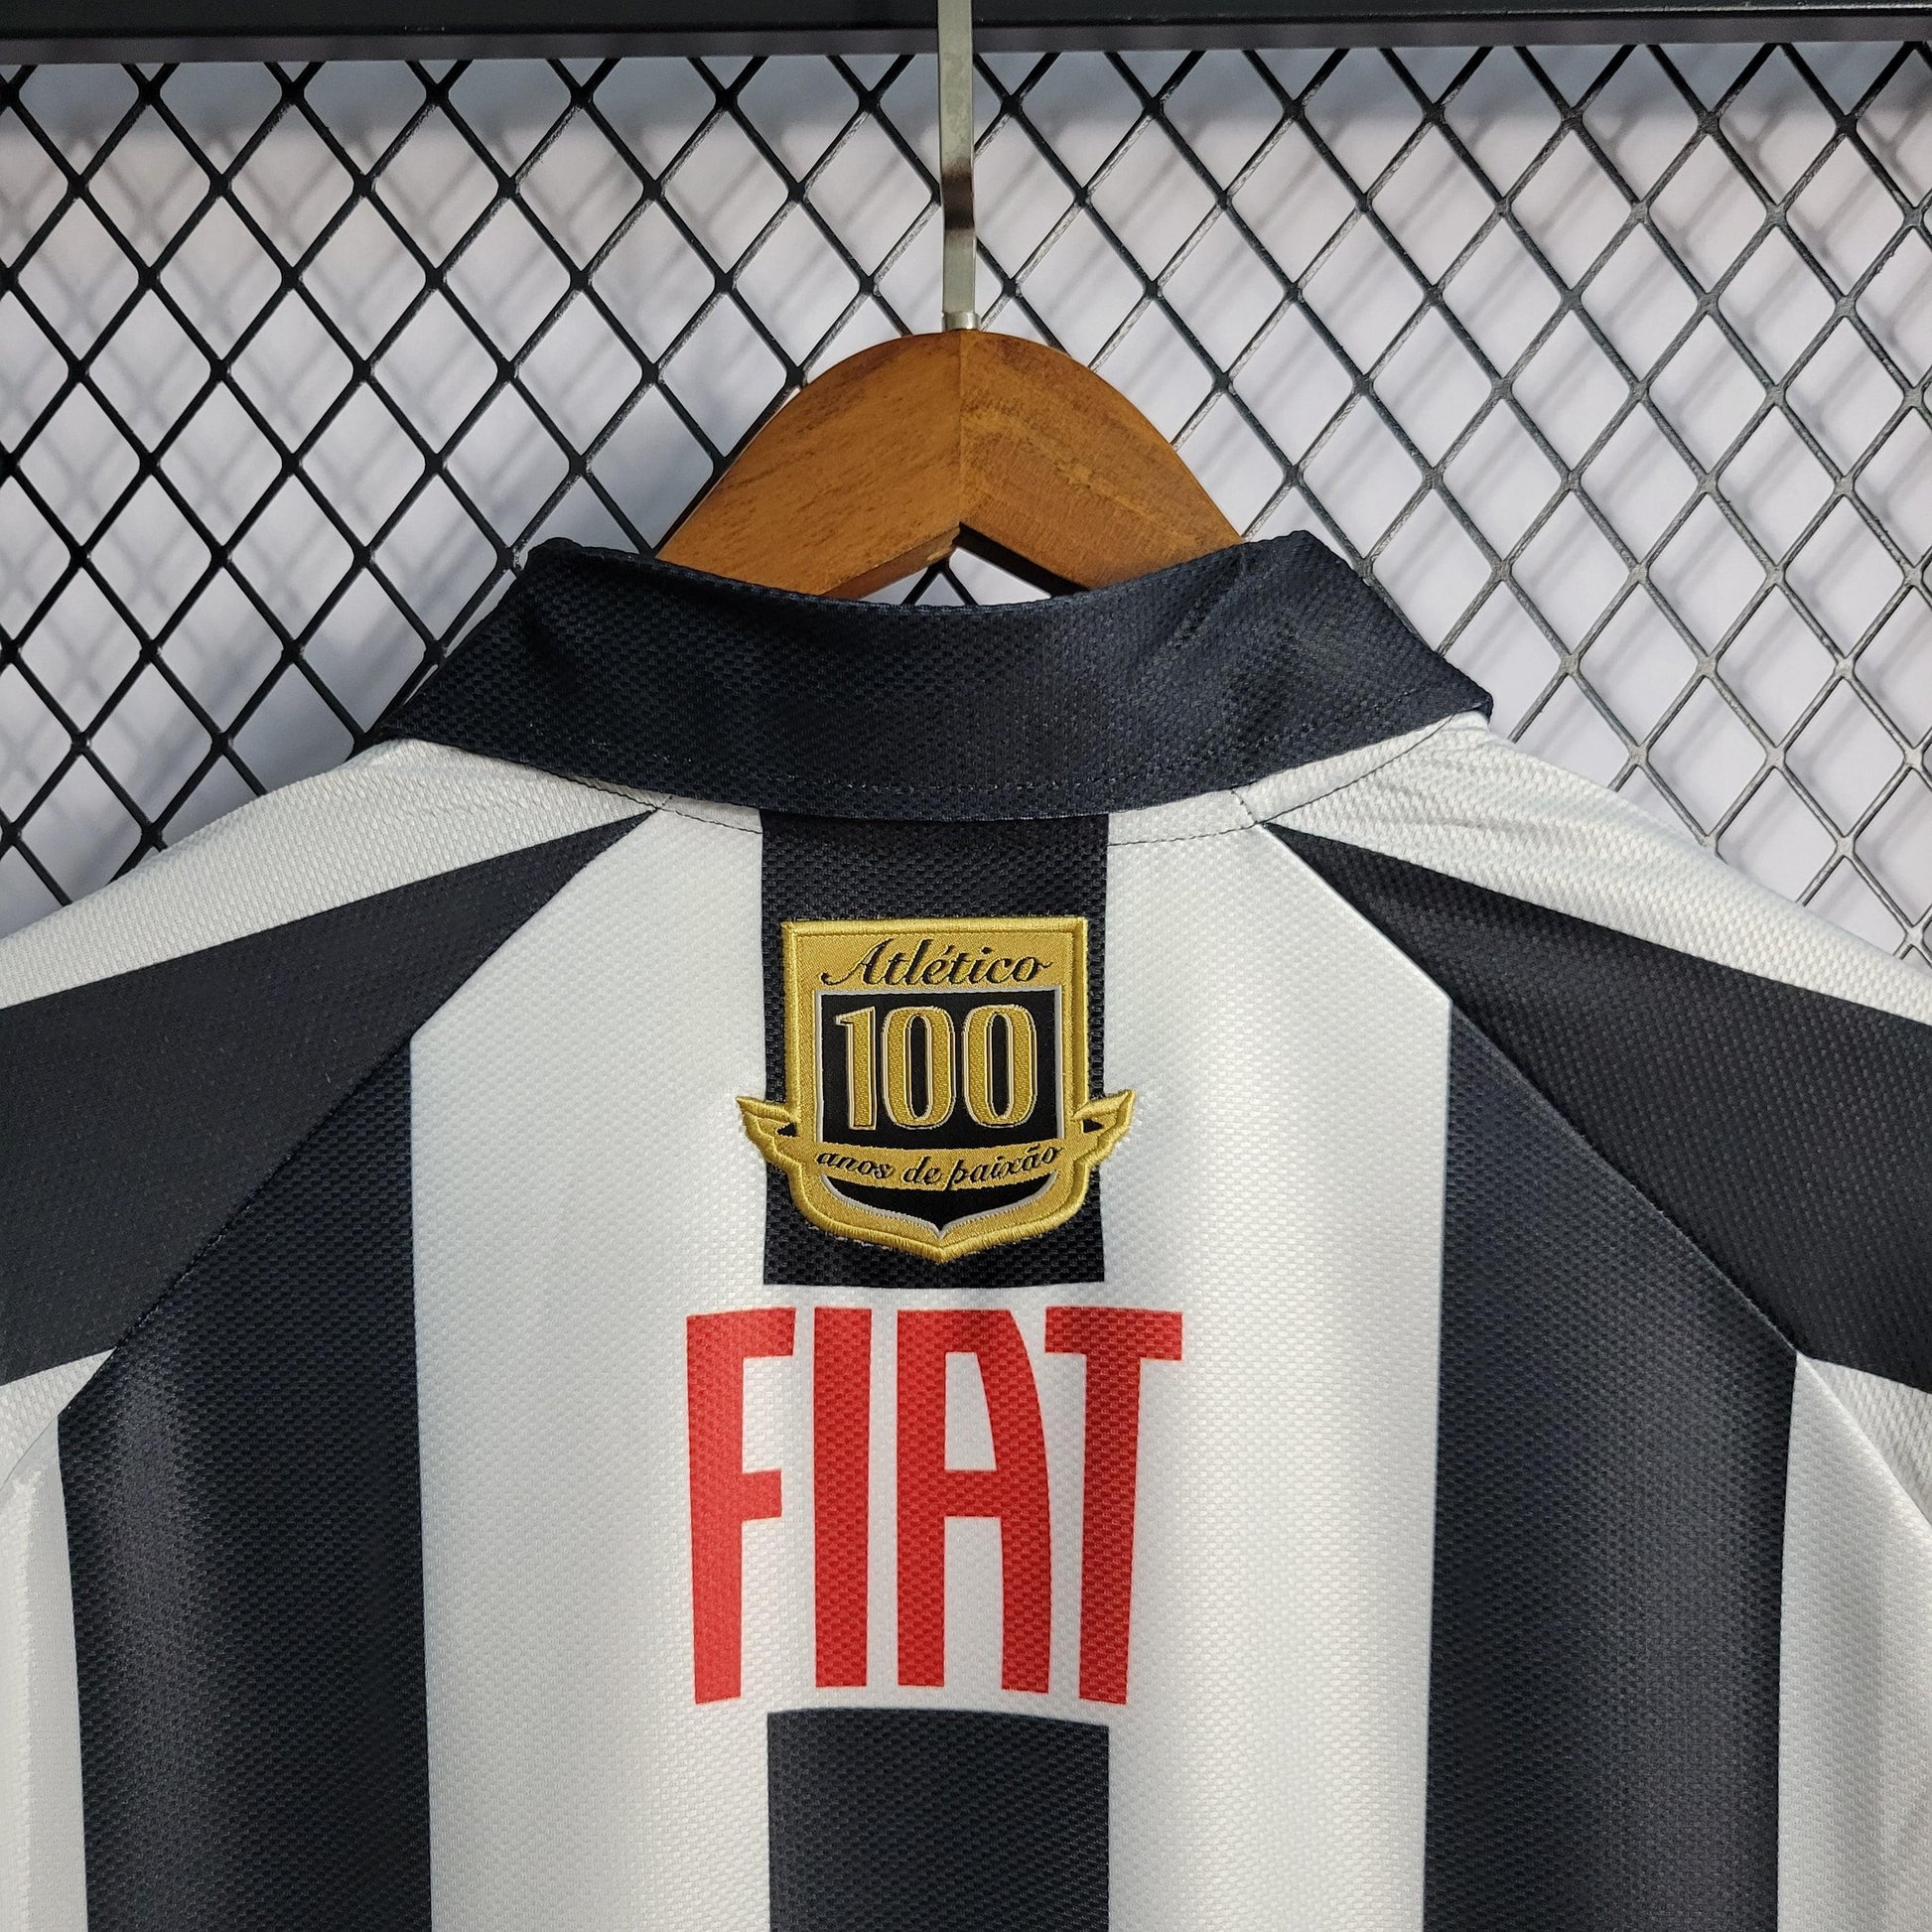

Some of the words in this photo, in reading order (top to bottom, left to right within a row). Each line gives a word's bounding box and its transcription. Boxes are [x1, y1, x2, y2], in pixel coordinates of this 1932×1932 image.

[821, 938, 1053, 986] Atlético
[835, 1004, 1037, 1131] 100
[816, 1151, 893, 1180] anos
[902, 1156, 943, 1185] de
[944, 1146, 1063, 1191] paixão
[686, 1306, 1182, 1705] FIAT
